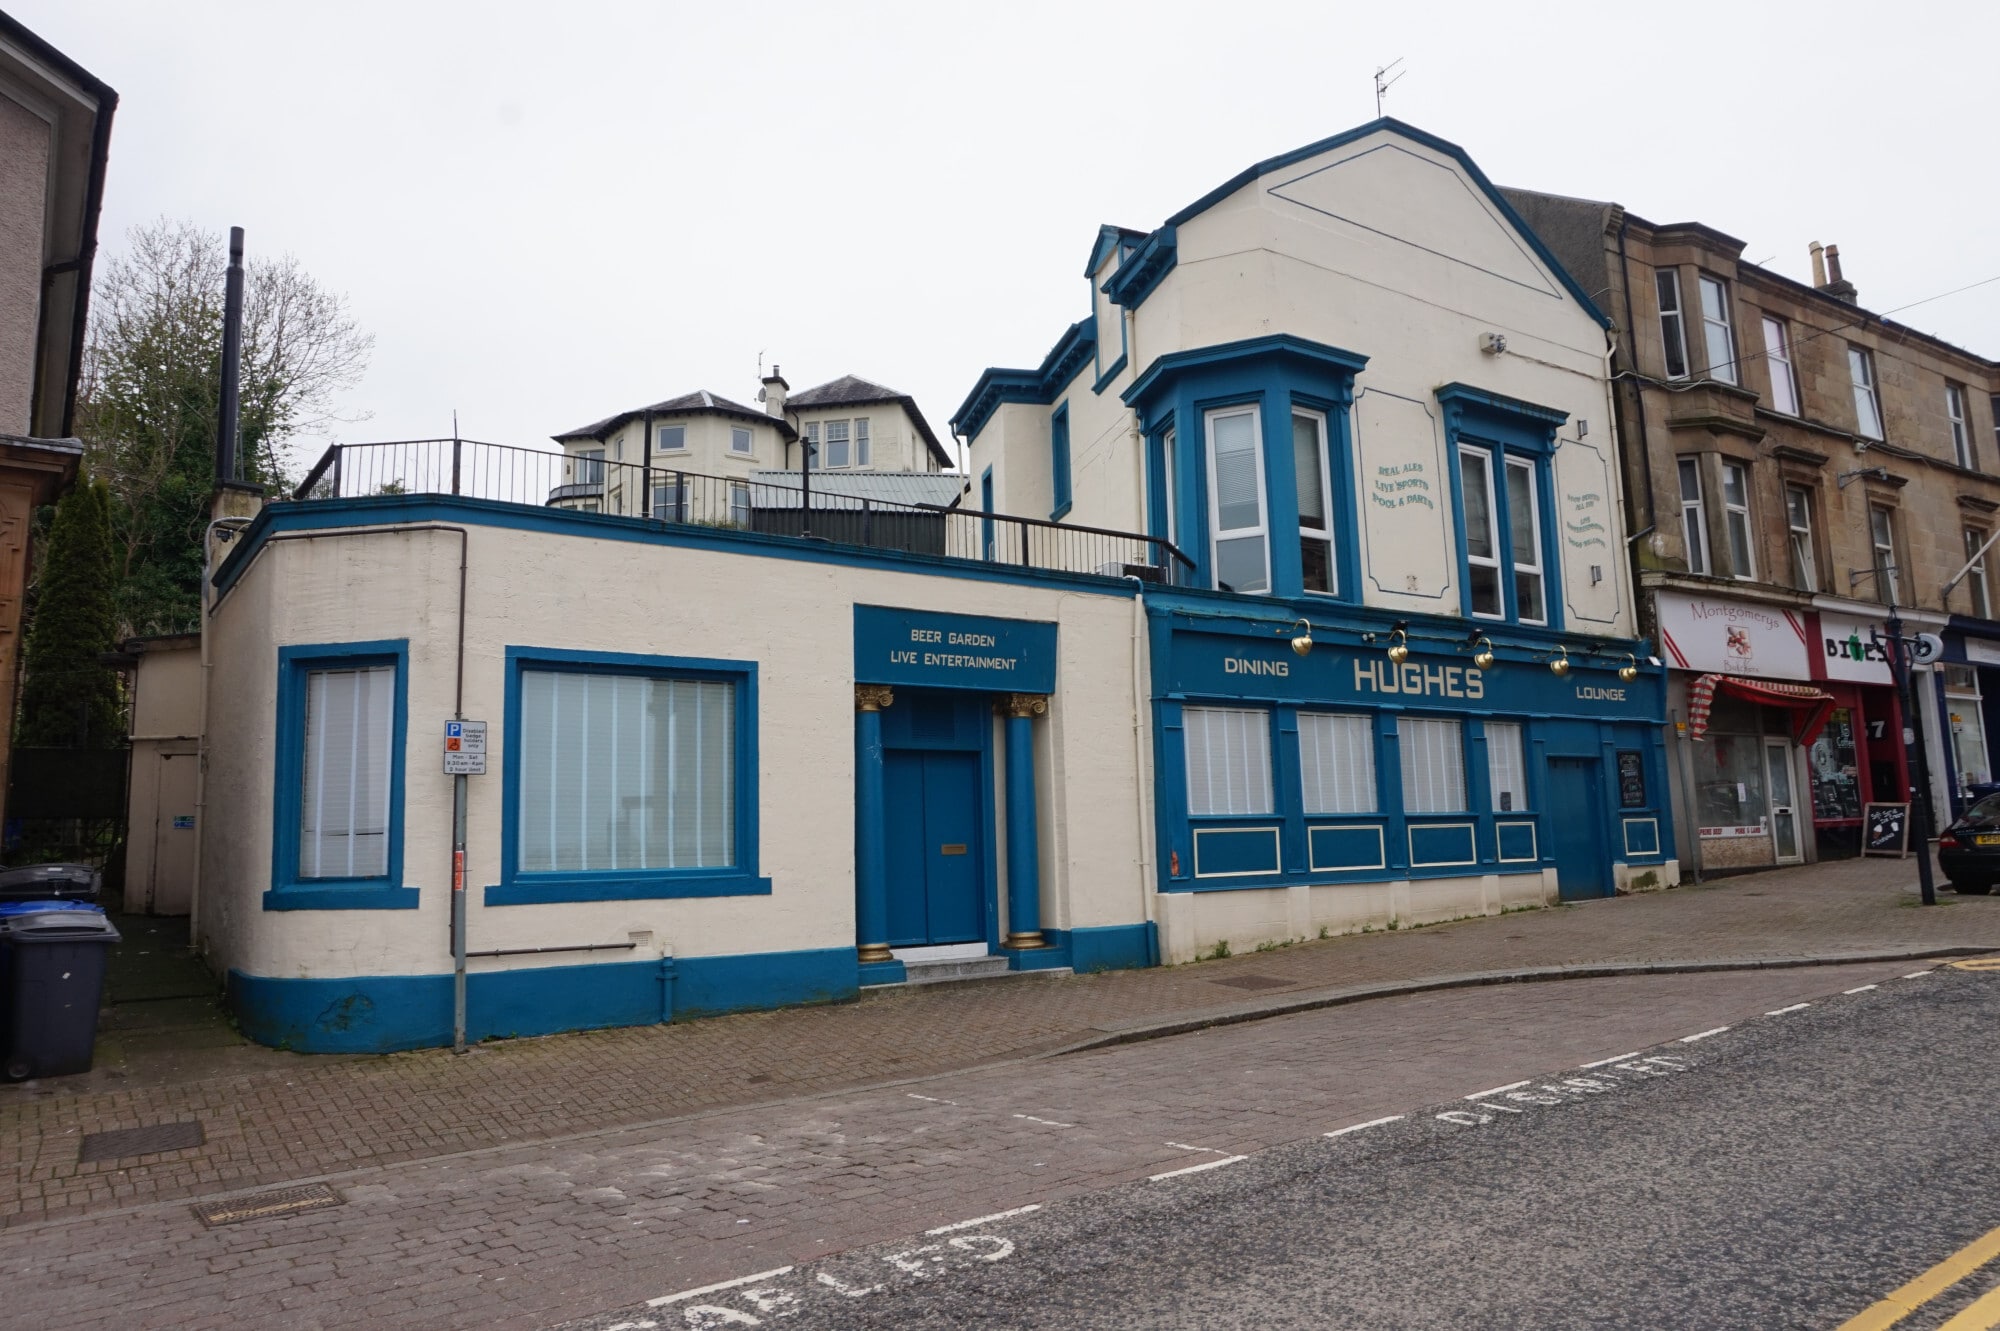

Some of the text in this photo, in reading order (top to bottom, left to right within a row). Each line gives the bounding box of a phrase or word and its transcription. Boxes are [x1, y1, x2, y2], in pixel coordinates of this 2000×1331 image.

[1378, 463, 1424, 476] REAL ALES
[1375, 479, 1429, 493] LIVE SPORTS
[1372, 492, 1397, 509] POOL
[1406, 494, 1434, 511] DARTS
[1691, 601, 1780, 631] Montgomerys
[911, 629, 995, 647] BEER GARDEN
[890, 650, 1017, 671] LIVE ENTERTAINMENT
[1224, 657, 1289, 677] DINING
[1353, 658, 1484, 699] HUGHES
[1576, 686, 1627, 701] LOUNGE
[450, 724, 460, 736] P
